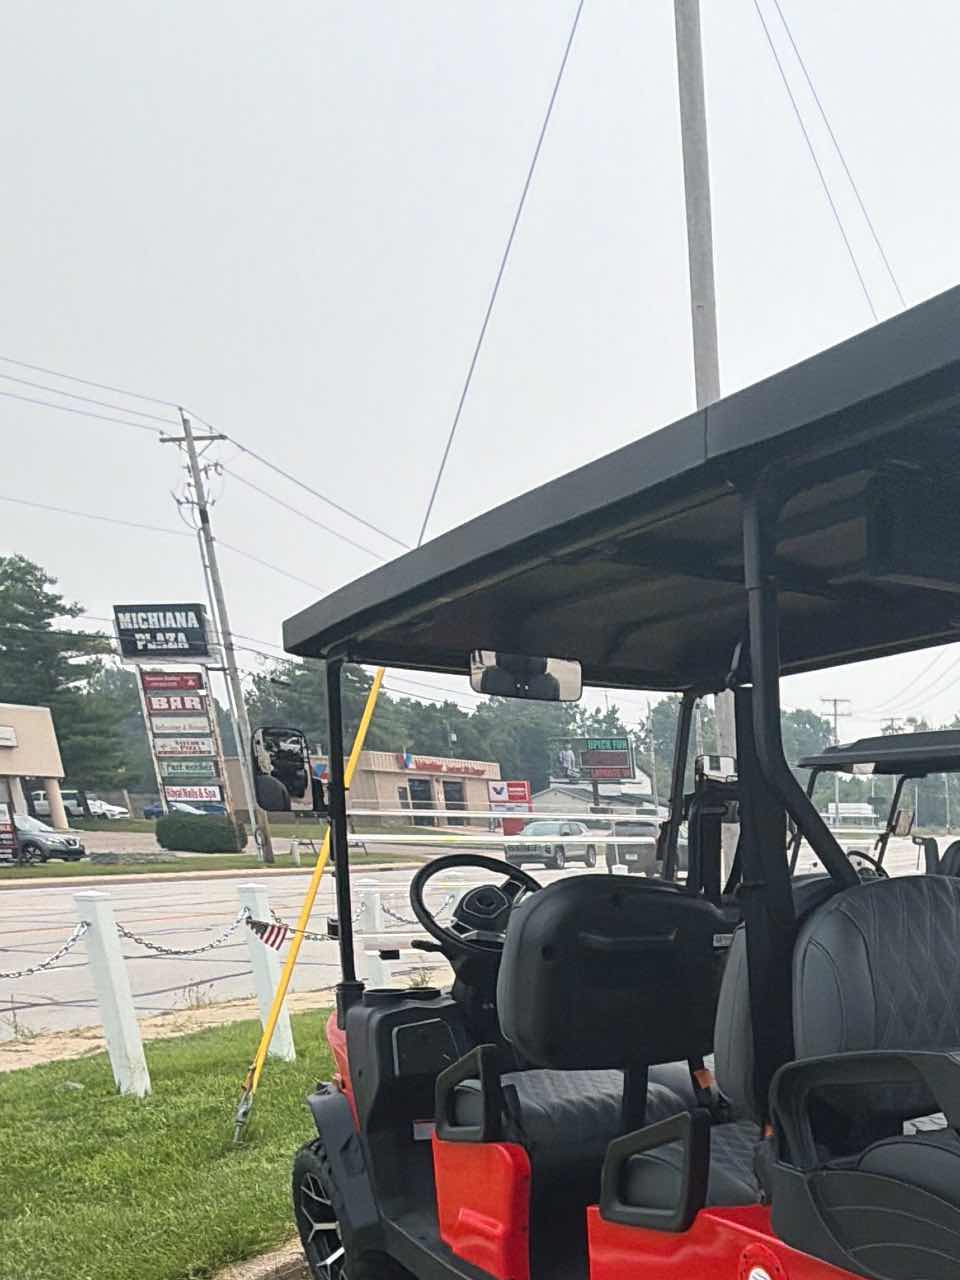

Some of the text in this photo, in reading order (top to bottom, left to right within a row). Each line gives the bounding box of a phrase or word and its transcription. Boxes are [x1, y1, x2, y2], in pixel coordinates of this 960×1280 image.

[117, 611, 200, 630] MICHIANA
[134, 632, 190, 650] PLAZA
[151, 696, 201, 710] BAR
